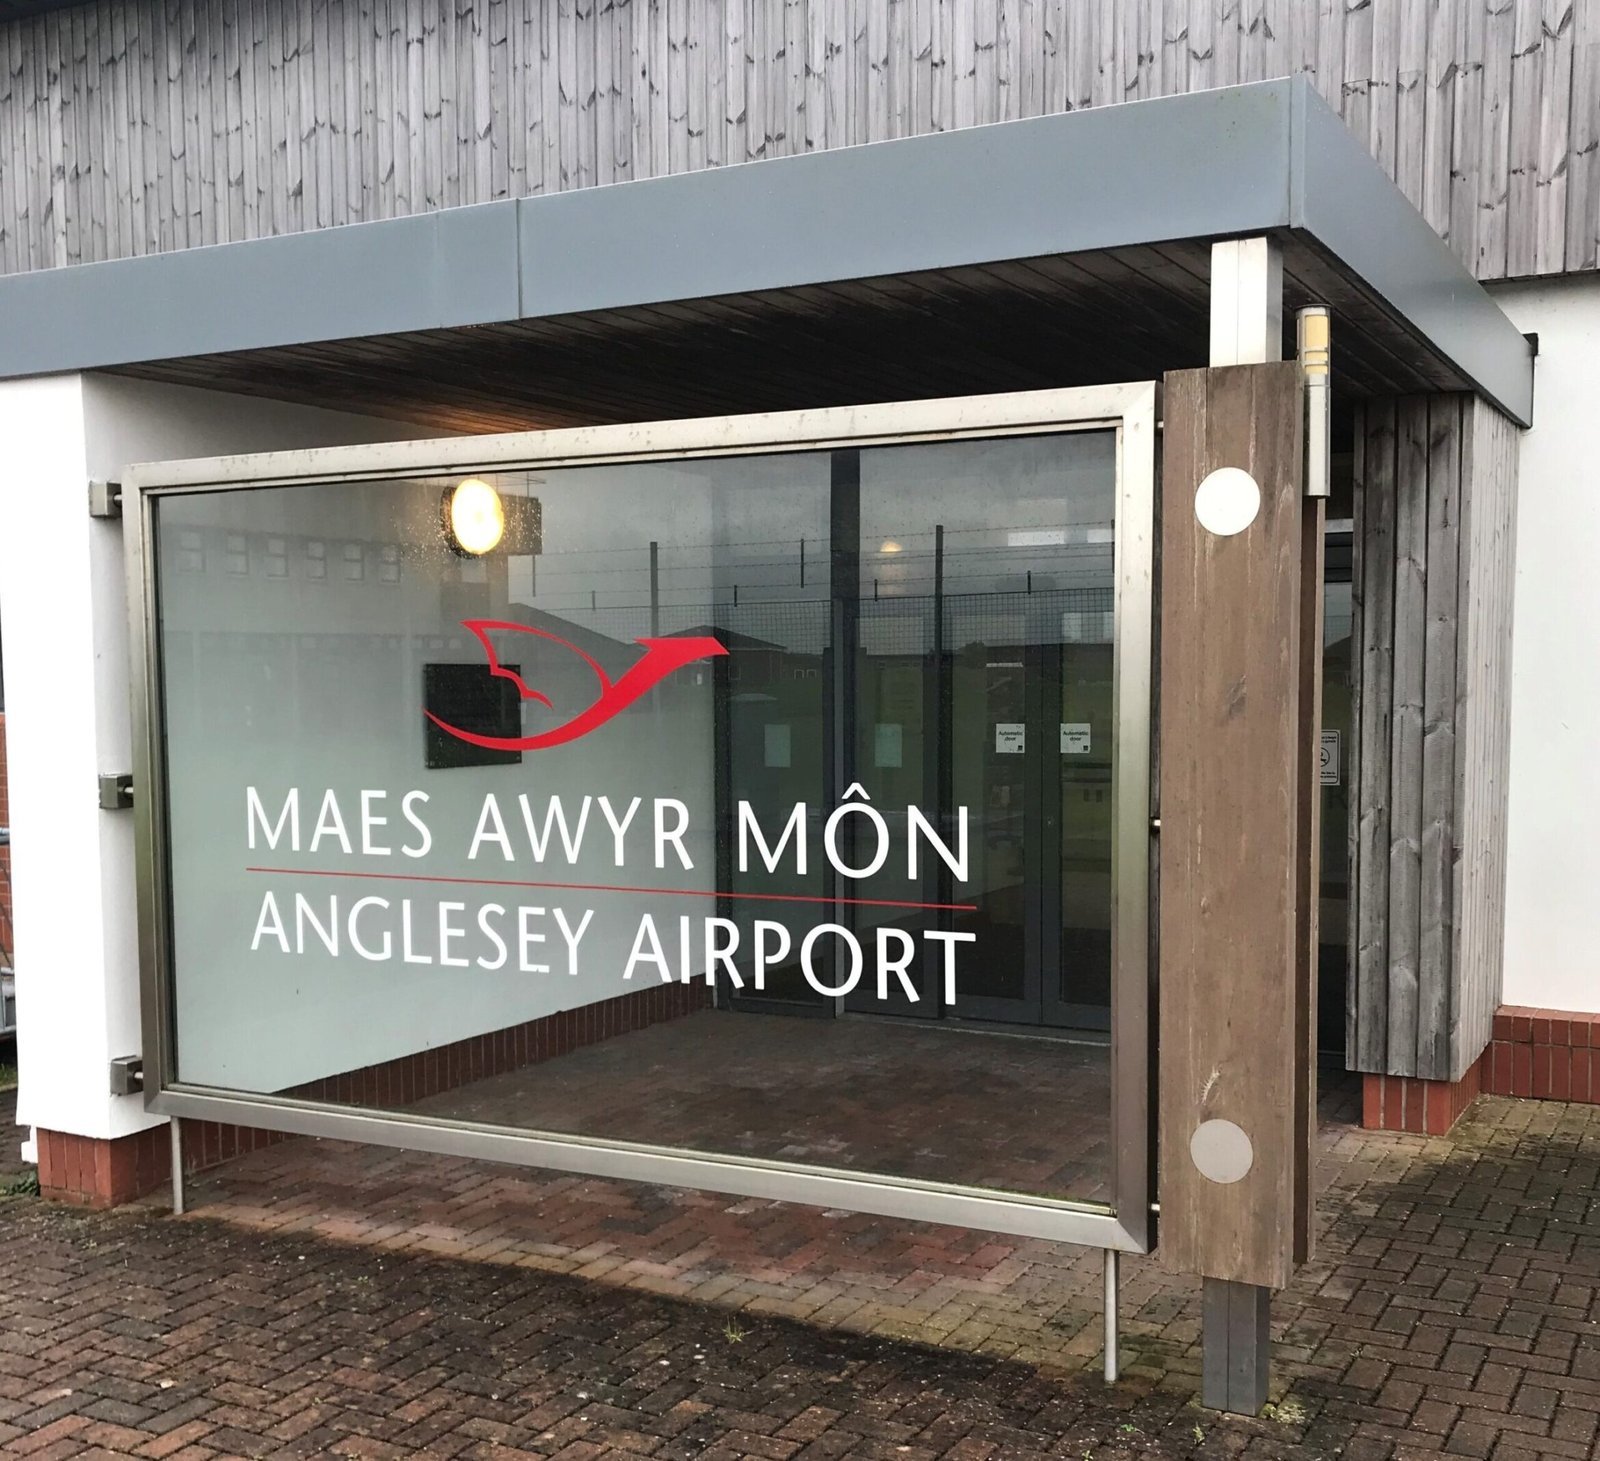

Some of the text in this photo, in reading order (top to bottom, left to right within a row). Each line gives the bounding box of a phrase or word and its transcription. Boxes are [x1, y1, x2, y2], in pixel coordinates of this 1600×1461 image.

[246, 781, 969, 883] MAES AWYR MÔN
[250, 890, 978, 1006] ANGLESEY AIRPORT
